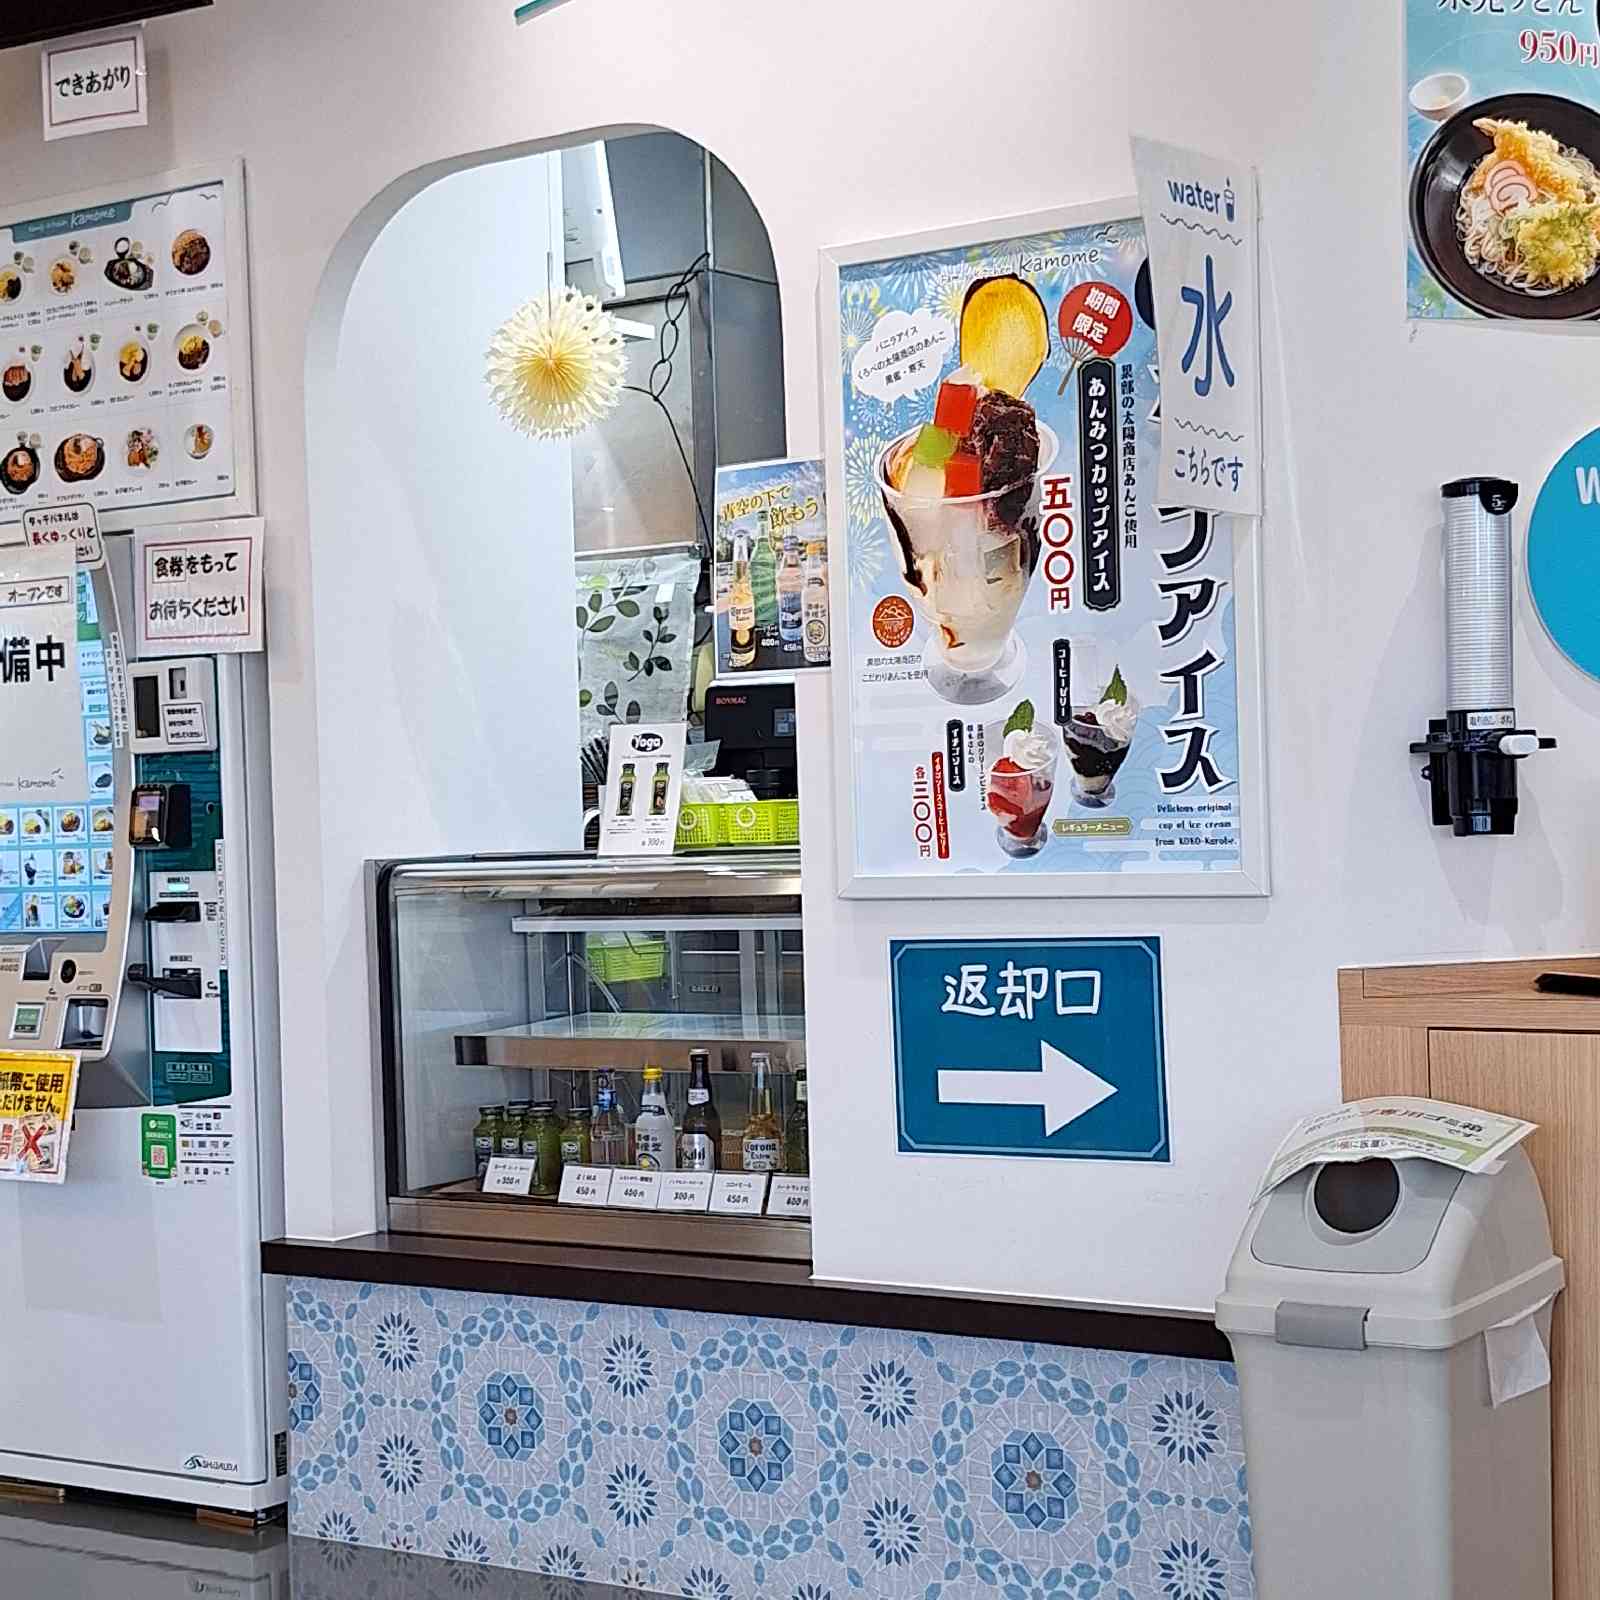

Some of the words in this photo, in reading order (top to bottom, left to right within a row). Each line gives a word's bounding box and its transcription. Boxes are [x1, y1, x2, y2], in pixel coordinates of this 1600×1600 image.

[1520, 31, 1598, 66] 950円
[55, 65, 130, 97] できあがり
[1167, 179, 1221, 214] water
[1084, 287, 1121, 319] 期間
[875, 326, 919, 352] バニラアイス
[1072, 313, 1109, 345] 限定
[1180, 253, 1236, 398] 水
[1121, 365, 1137, 549] 黒部の太陽商店あんこ使用
[1174, 446, 1244, 492] こちらです
[1088, 377, 1111, 591] あんみつカップアイス
[721, 485, 792, 522] 青空の下で
[769, 498, 818, 530] 飲もう
[29, 511, 79, 526] タッチパネルは
[32, 527, 96, 546] 長くゆっくりと
[154, 552, 239, 578] 食券をもって
[8, 584, 64, 602] オープンです
[149, 596, 246, 621] お待ちください
[0, 634, 66, 684] 備中
[1058, 648, 1068, 717] コーヒーゼリー
[634, 734, 661, 750] Yoga
[951, 727, 961, 785] イチゴソース
[1197, 802, 1232, 813] original
[1062, 822, 1125, 833] レギュラーメニュー
[1158, 822, 1174, 831] cup
[1177, 820, 1185, 829] of
[1189, 820, 1202, 829] ice
[1205, 821, 1232, 829] cream
[1155, 837, 1175, 847] from
[941, 961, 1101, 1020] 返却口
[745, 1142, 777, 1152] Corona
[576, 1185, 596, 1196] 450円
[673, 1191, 696, 1201] 300円
[726, 1194, 749, 1204] 450円
